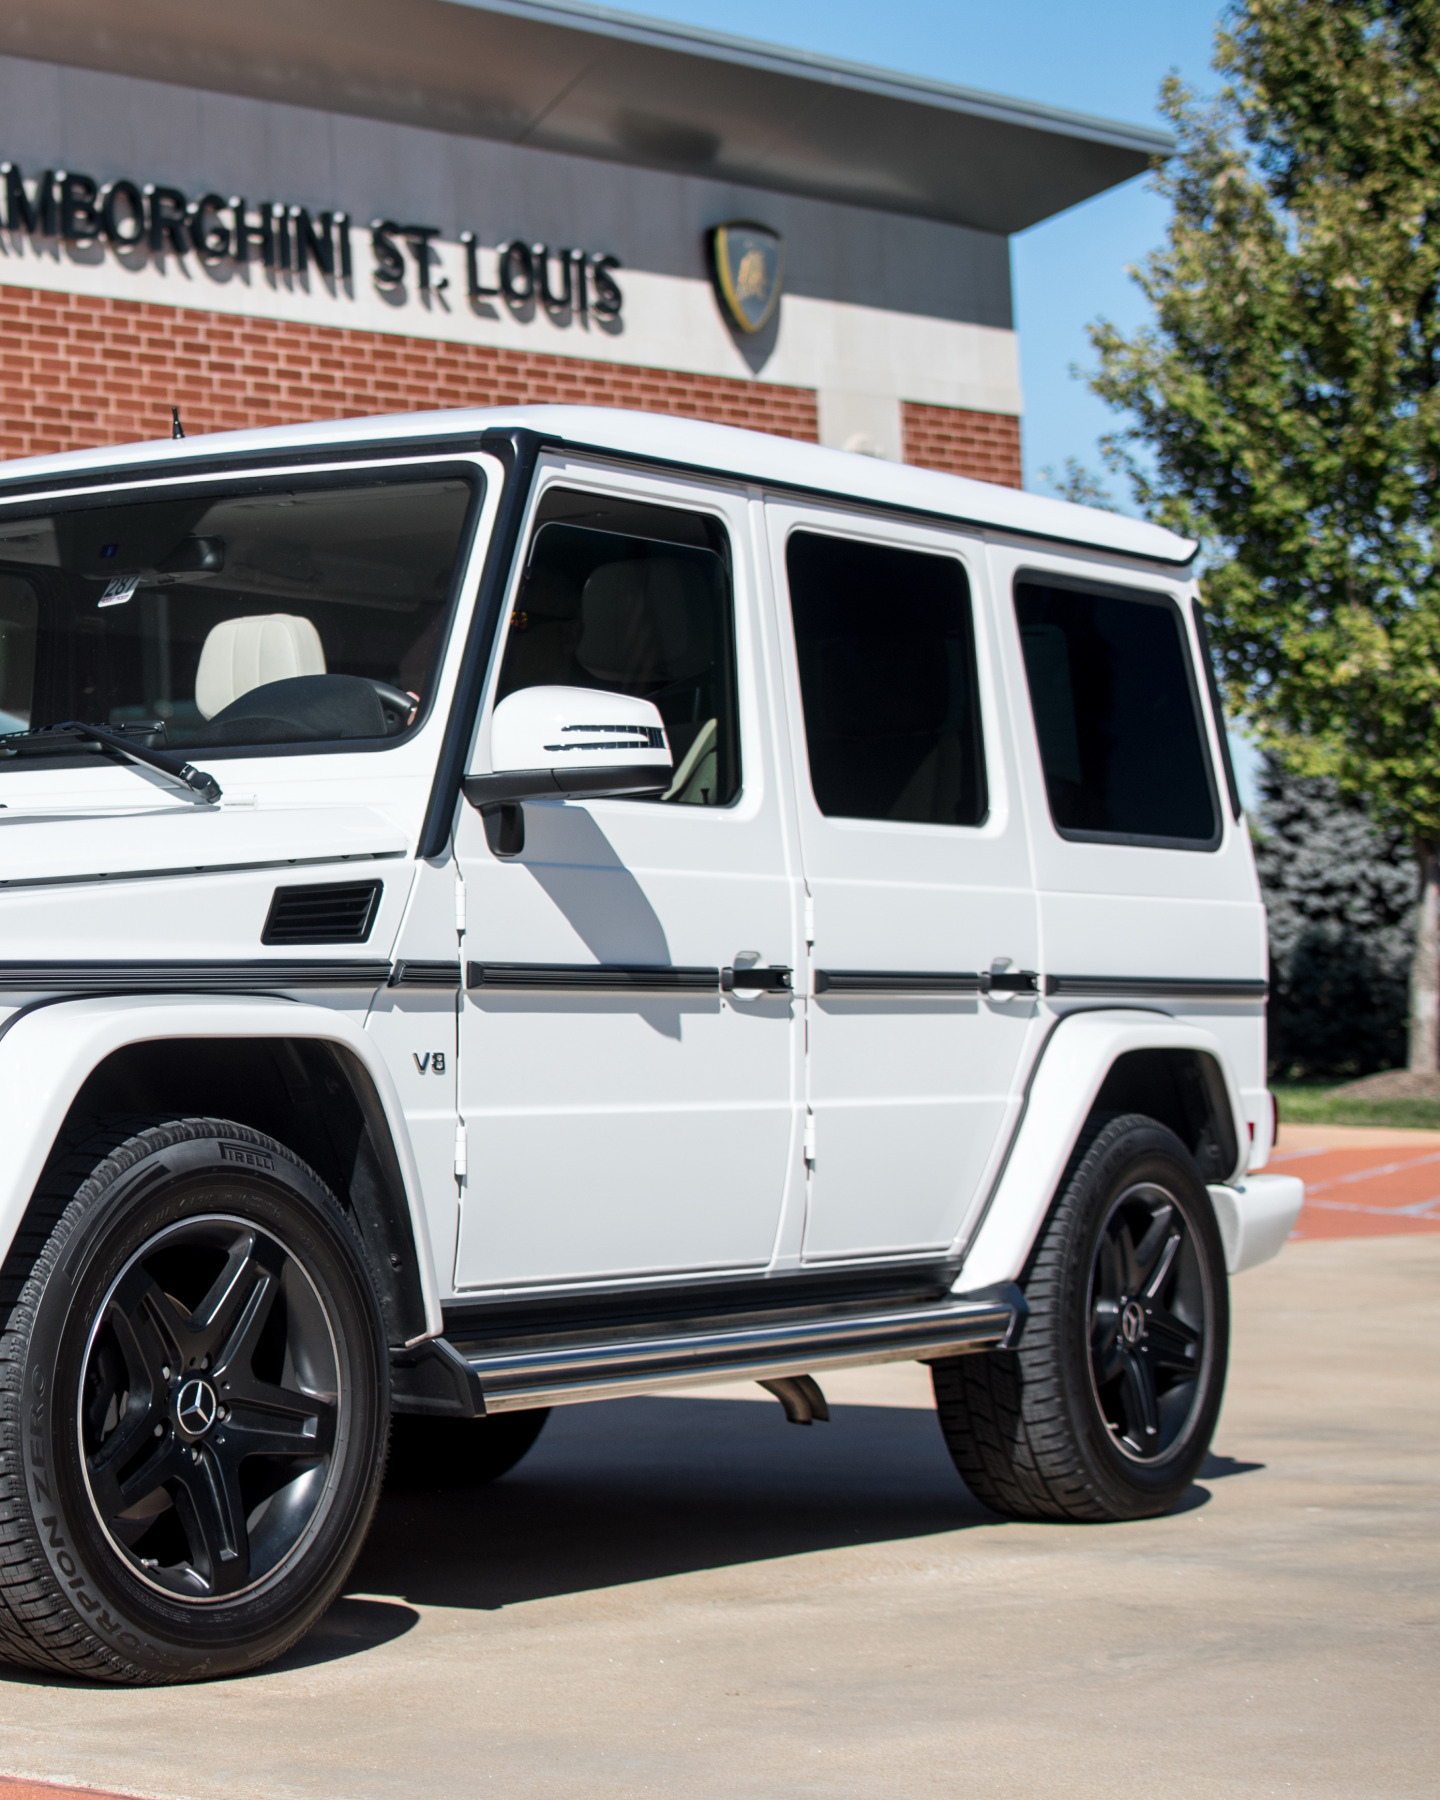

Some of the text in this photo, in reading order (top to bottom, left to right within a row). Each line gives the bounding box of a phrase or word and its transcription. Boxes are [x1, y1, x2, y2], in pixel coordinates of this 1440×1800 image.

[371, 219, 448, 290] ST.
[460, 230, 623, 316] LOUIS
[413, 1052, 445, 1074] V8
[218, 1141, 275, 1171] PIRELLI
[29, 1364, 53, 1502] ZERO
